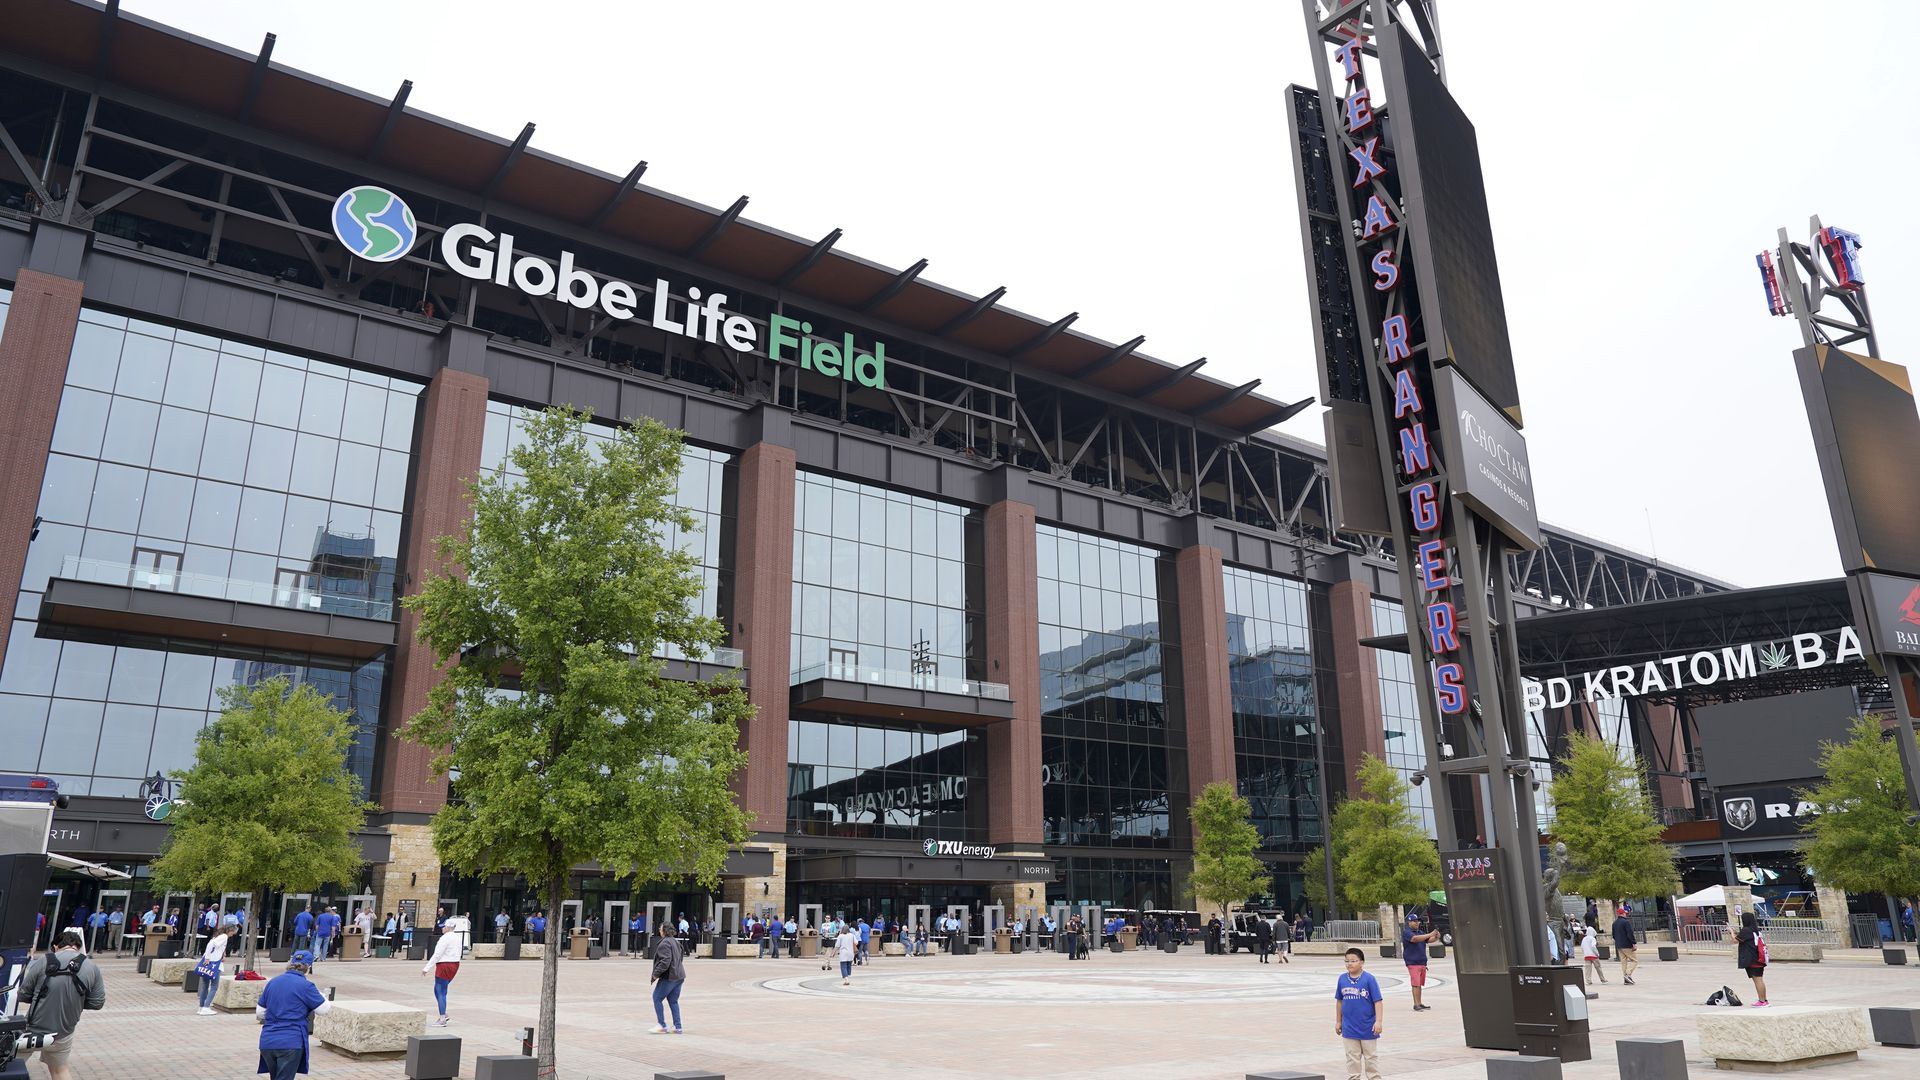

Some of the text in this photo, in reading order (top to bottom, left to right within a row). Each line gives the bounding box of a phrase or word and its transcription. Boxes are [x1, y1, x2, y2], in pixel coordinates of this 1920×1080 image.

[440, 222, 886, 390] Globe Life Field
[1334, 37, 1468, 715] TEXAS RANGERS
[1468, 413, 1528, 486] CHOCTAW
[1478, 462, 1503, 490] CASINOS
[1507, 488, 1530, 512] RESORTS
[1583, 643, 1758, 704] KRATOM
[1024, 867, 1050, 875] NORTH
[1447, 857, 1492, 870] TEXAS
[197, 966, 215, 977] TEXAS
